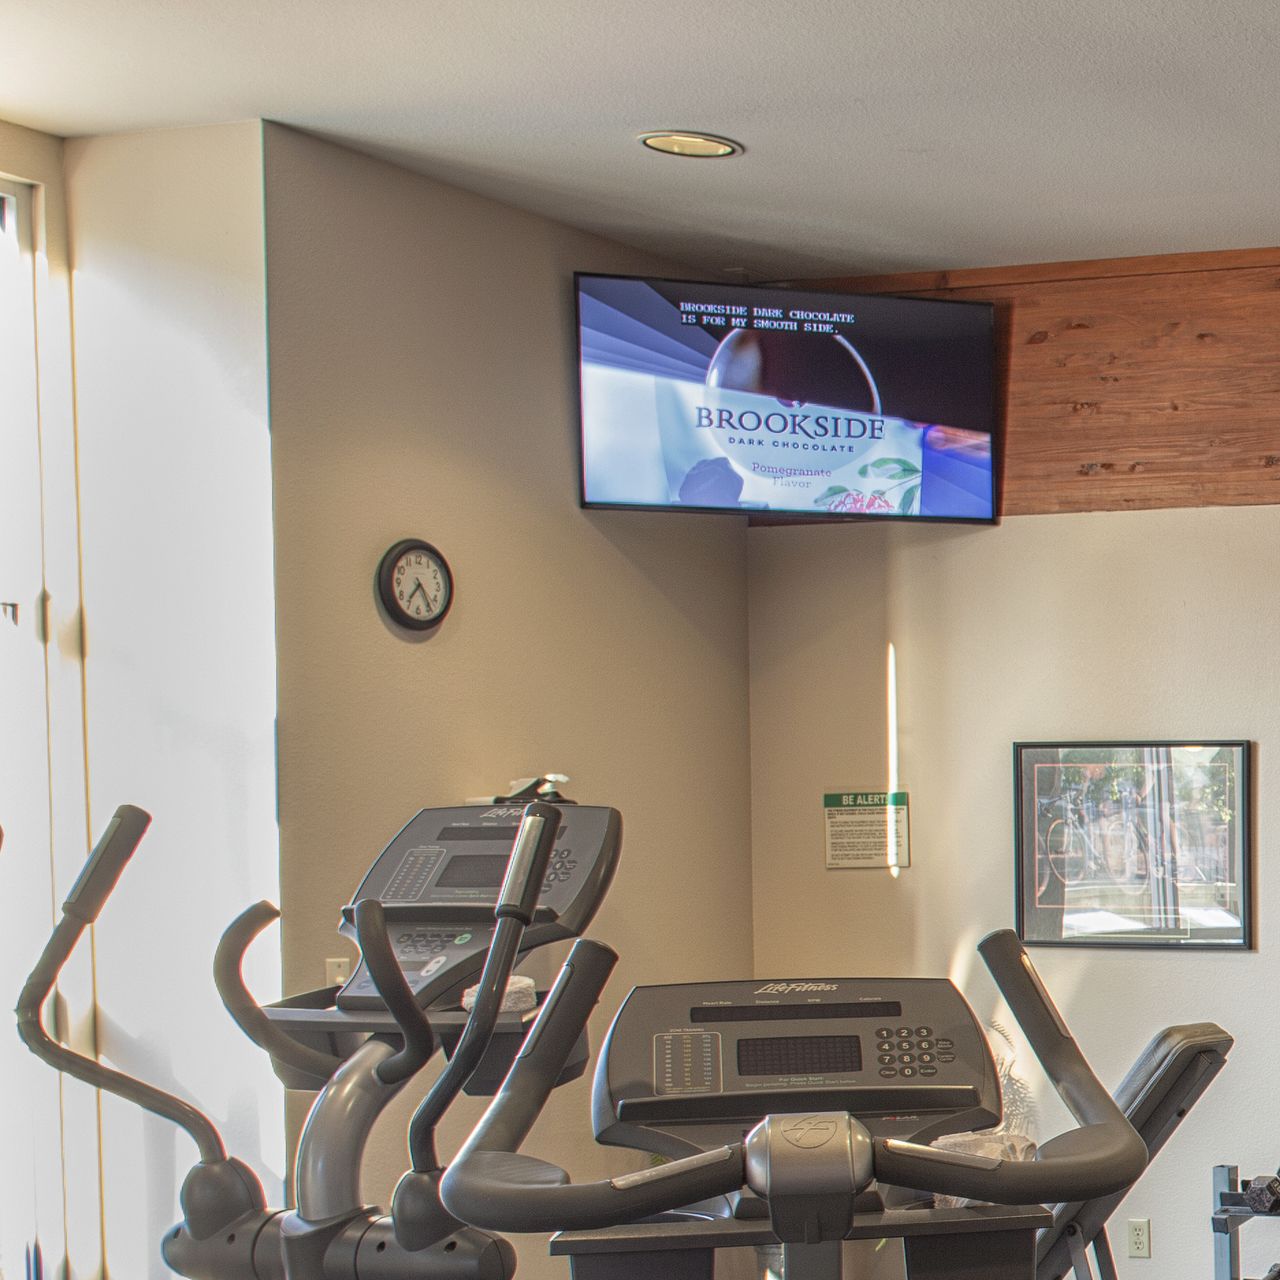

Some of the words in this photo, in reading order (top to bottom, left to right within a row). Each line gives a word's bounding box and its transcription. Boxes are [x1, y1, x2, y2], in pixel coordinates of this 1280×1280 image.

[680, 302, 748, 316] BROOKSIDE
[753, 307, 783, 319] DARK
[789, 310, 855, 323] CHOCOLATE
[682, 314, 696, 324] IS
[702, 315, 725, 326] FOR
[731, 317, 747, 327] MY
[754, 319, 797, 331] SMOOTH
[804, 322, 838, 333] SIDE.
[696, 407, 885, 440] BROOKSIDE
[728, 437, 765, 446] DARK
[772, 440, 855, 453] CHOCOLATE
[752, 462, 832, 478] Pomegranate
[772, 476, 812, 489] Flavor
[842, 795, 855, 805] BE
